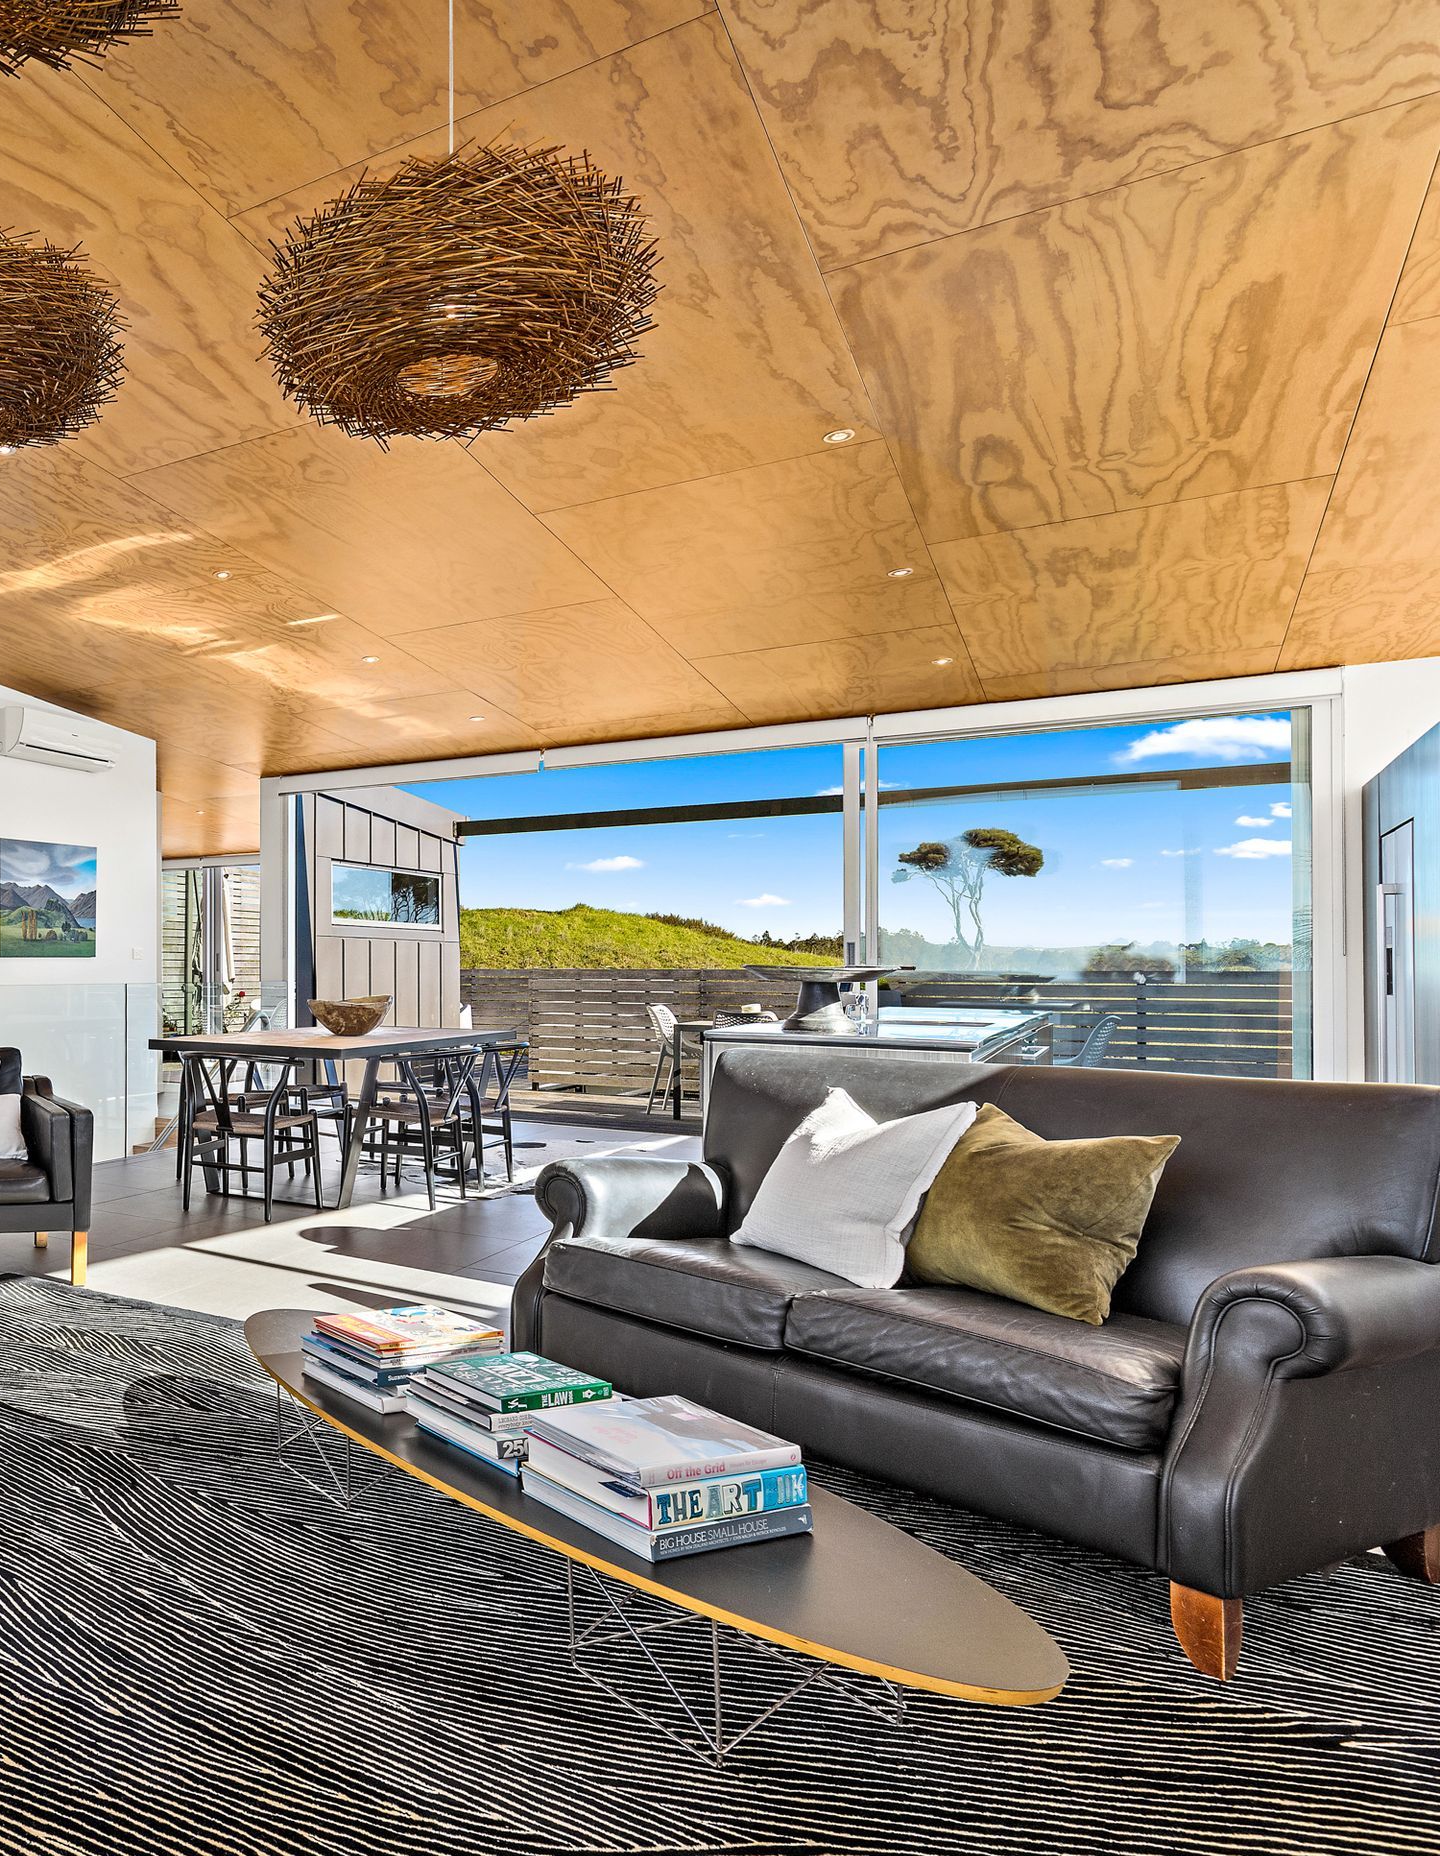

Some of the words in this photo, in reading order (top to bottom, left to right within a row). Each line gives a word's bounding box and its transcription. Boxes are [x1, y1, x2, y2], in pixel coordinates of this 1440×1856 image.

[548, 1391, 568, 1407] LAW
[666, 1468, 682, 1480] Off
[685, 1465, 702, 1477] the
[704, 1462, 726, 1475] Grid
[656, 1489, 704, 1525] THE
[705, 1478, 762, 1519] ART
[659, 1538, 675, 1550] BIG
[675, 1531, 707, 1547] HOUSE
[707, 1526, 738, 1541] SMALL
[738, 1519, 769, 1534] HOUSE
